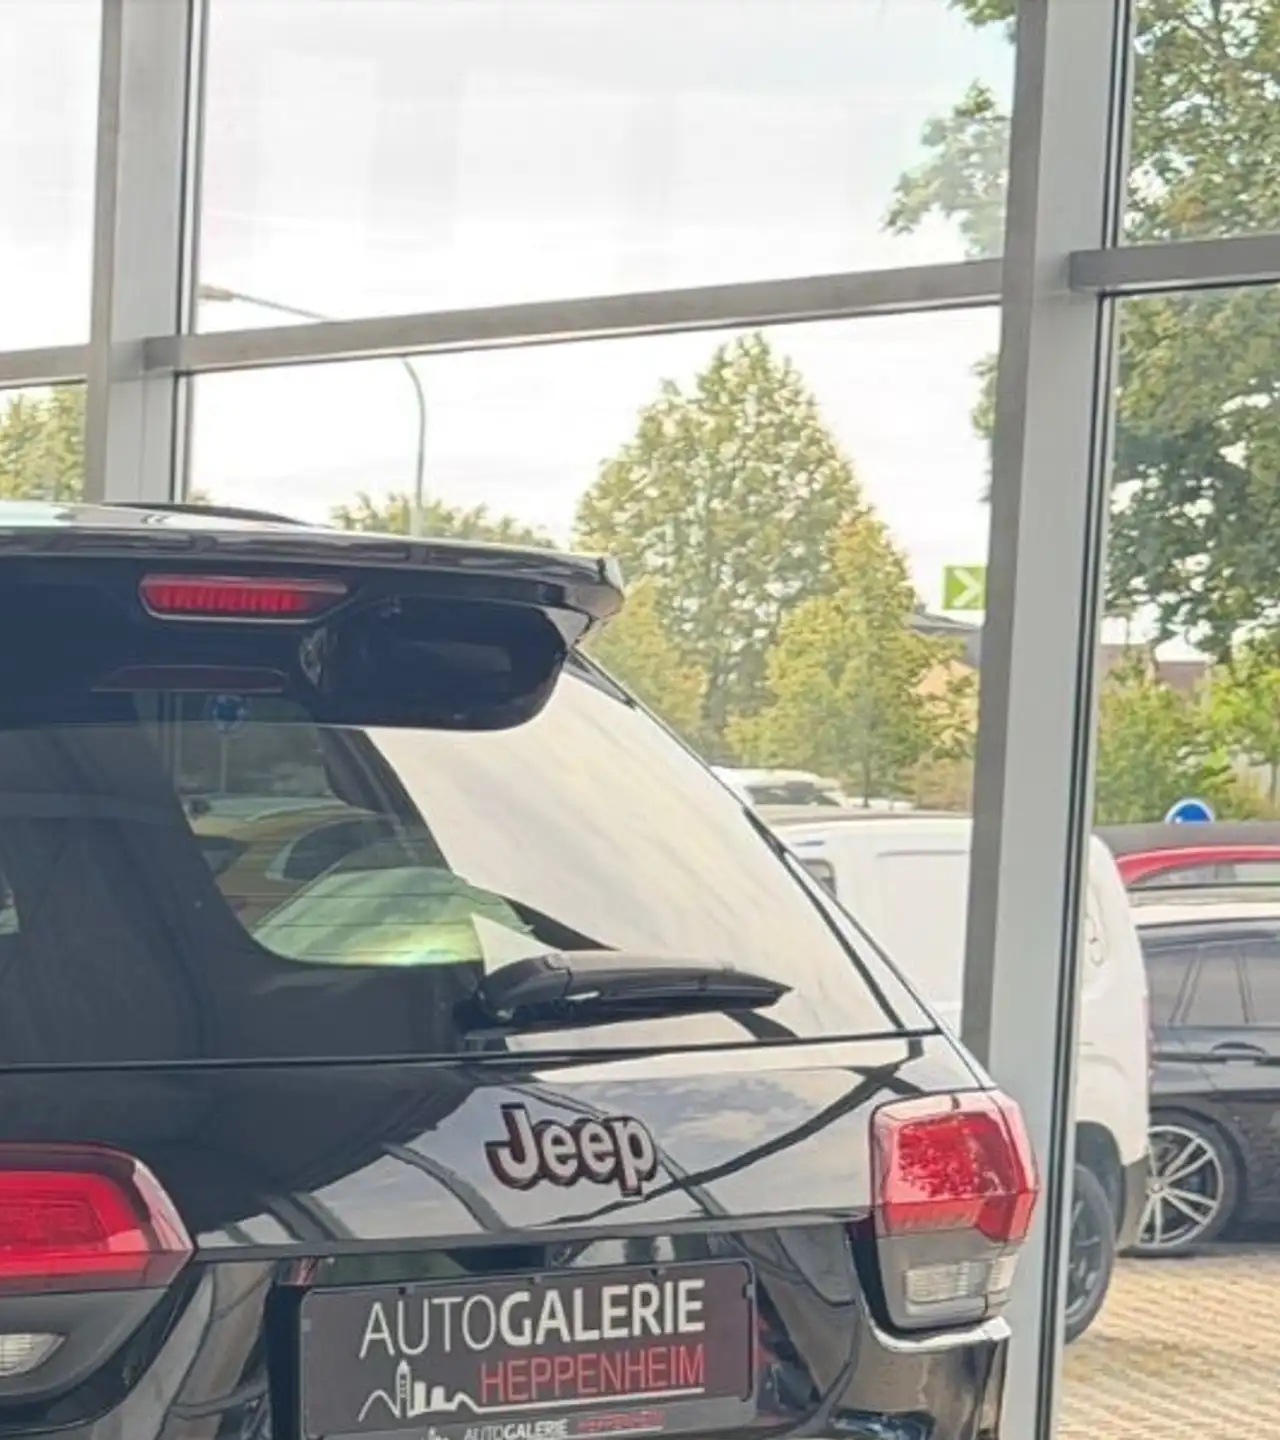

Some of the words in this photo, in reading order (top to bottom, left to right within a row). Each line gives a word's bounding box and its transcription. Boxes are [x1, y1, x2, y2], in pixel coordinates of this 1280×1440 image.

[484, 1102, 658, 1197] Jeep
[358, 1279, 706, 1360] AUTOGALERIE
[480, 1343, 706, 1404] HEPPENHEIM
